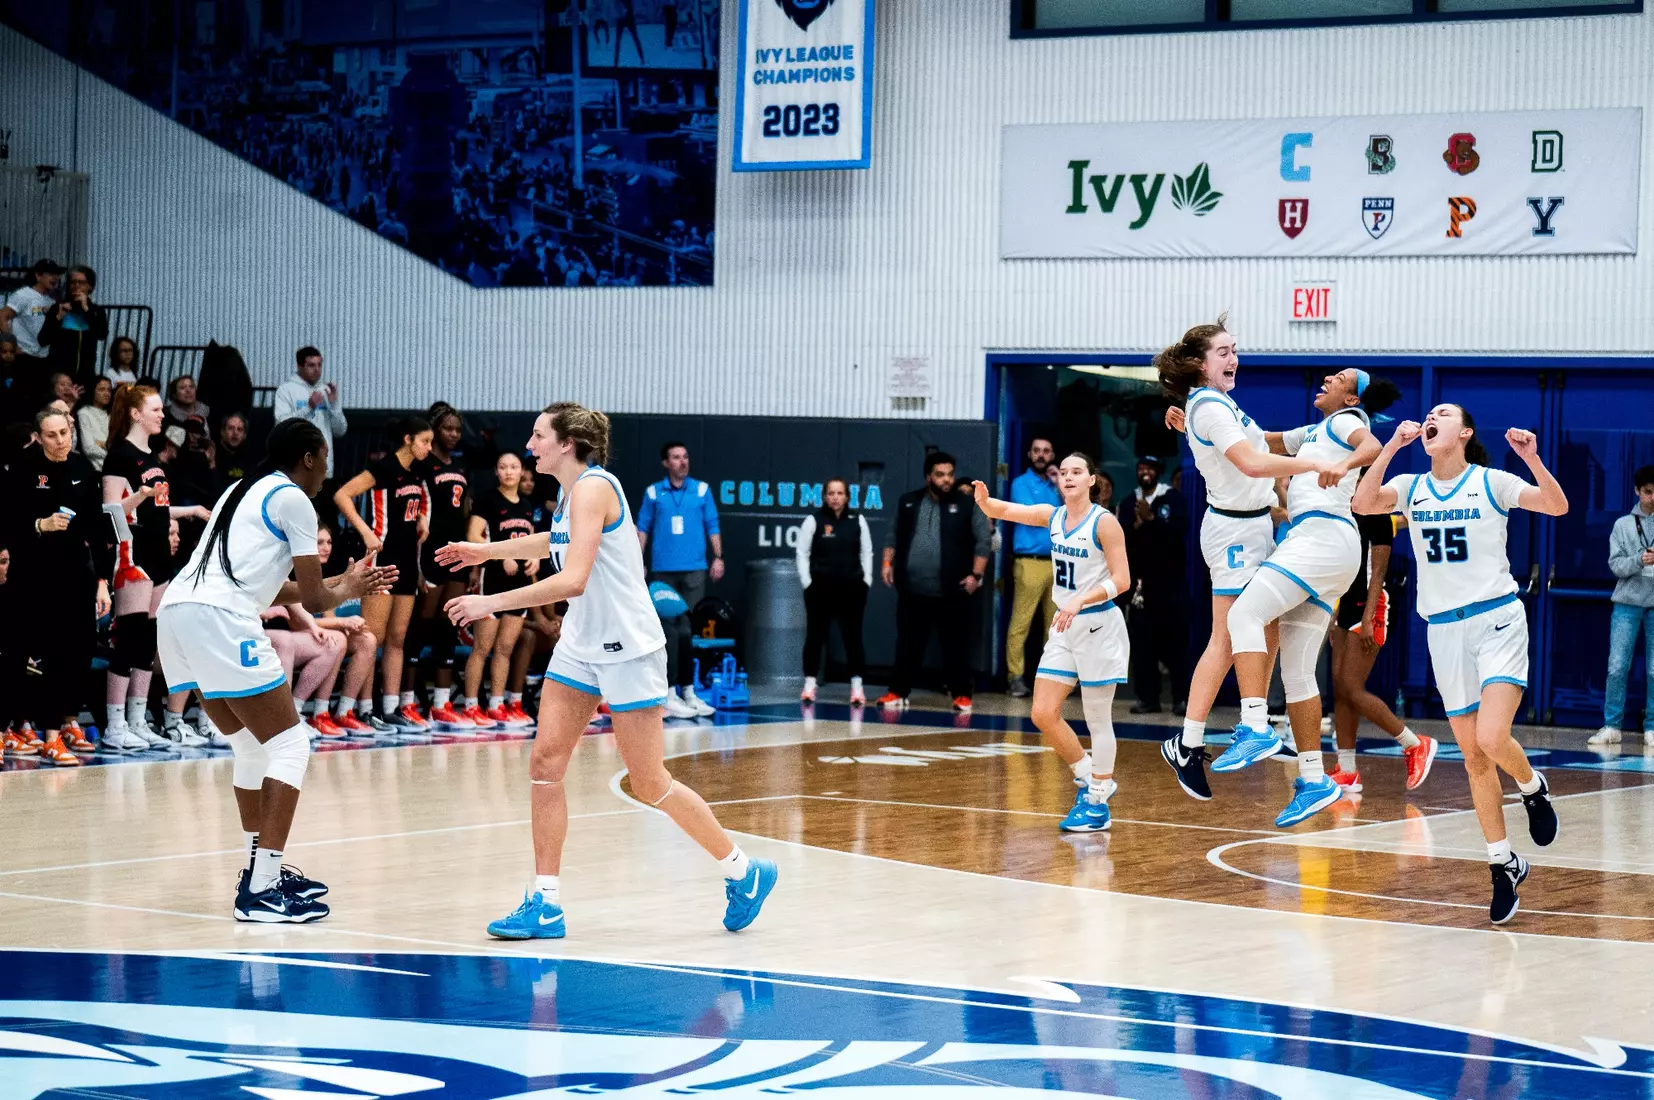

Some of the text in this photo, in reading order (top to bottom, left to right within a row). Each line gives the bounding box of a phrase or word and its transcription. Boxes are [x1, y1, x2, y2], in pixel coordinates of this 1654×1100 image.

[756, 45, 854, 64] IVY LEAGUE
[753, 67, 855, 85] CHAMPIONS
[763, 103, 840, 137] 2023
[1280, 133, 1313, 182] C
[1531, 130, 1563, 173] D
[1065, 160, 1165, 230] Ivy
[1364, 199, 1392, 208] PENN
[1283, 202, 1302, 228] H
[1371, 212, 1386, 231] P
[1446, 196, 1477, 238] P
[1527, 196, 1564, 237] Y
[1293, 288, 1330, 318] EXIT
[452, 484, 463, 507] 3
[720, 480, 883, 510] COLUMIA
[1411, 508, 1481, 522] COLUMBIA
[758, 525, 800, 548] LIO
[1421, 526, 1469, 563] 35
[1227, 544, 1244, 569] C
[1055, 559, 1076, 590] 21
[240, 640, 259, 667] C
